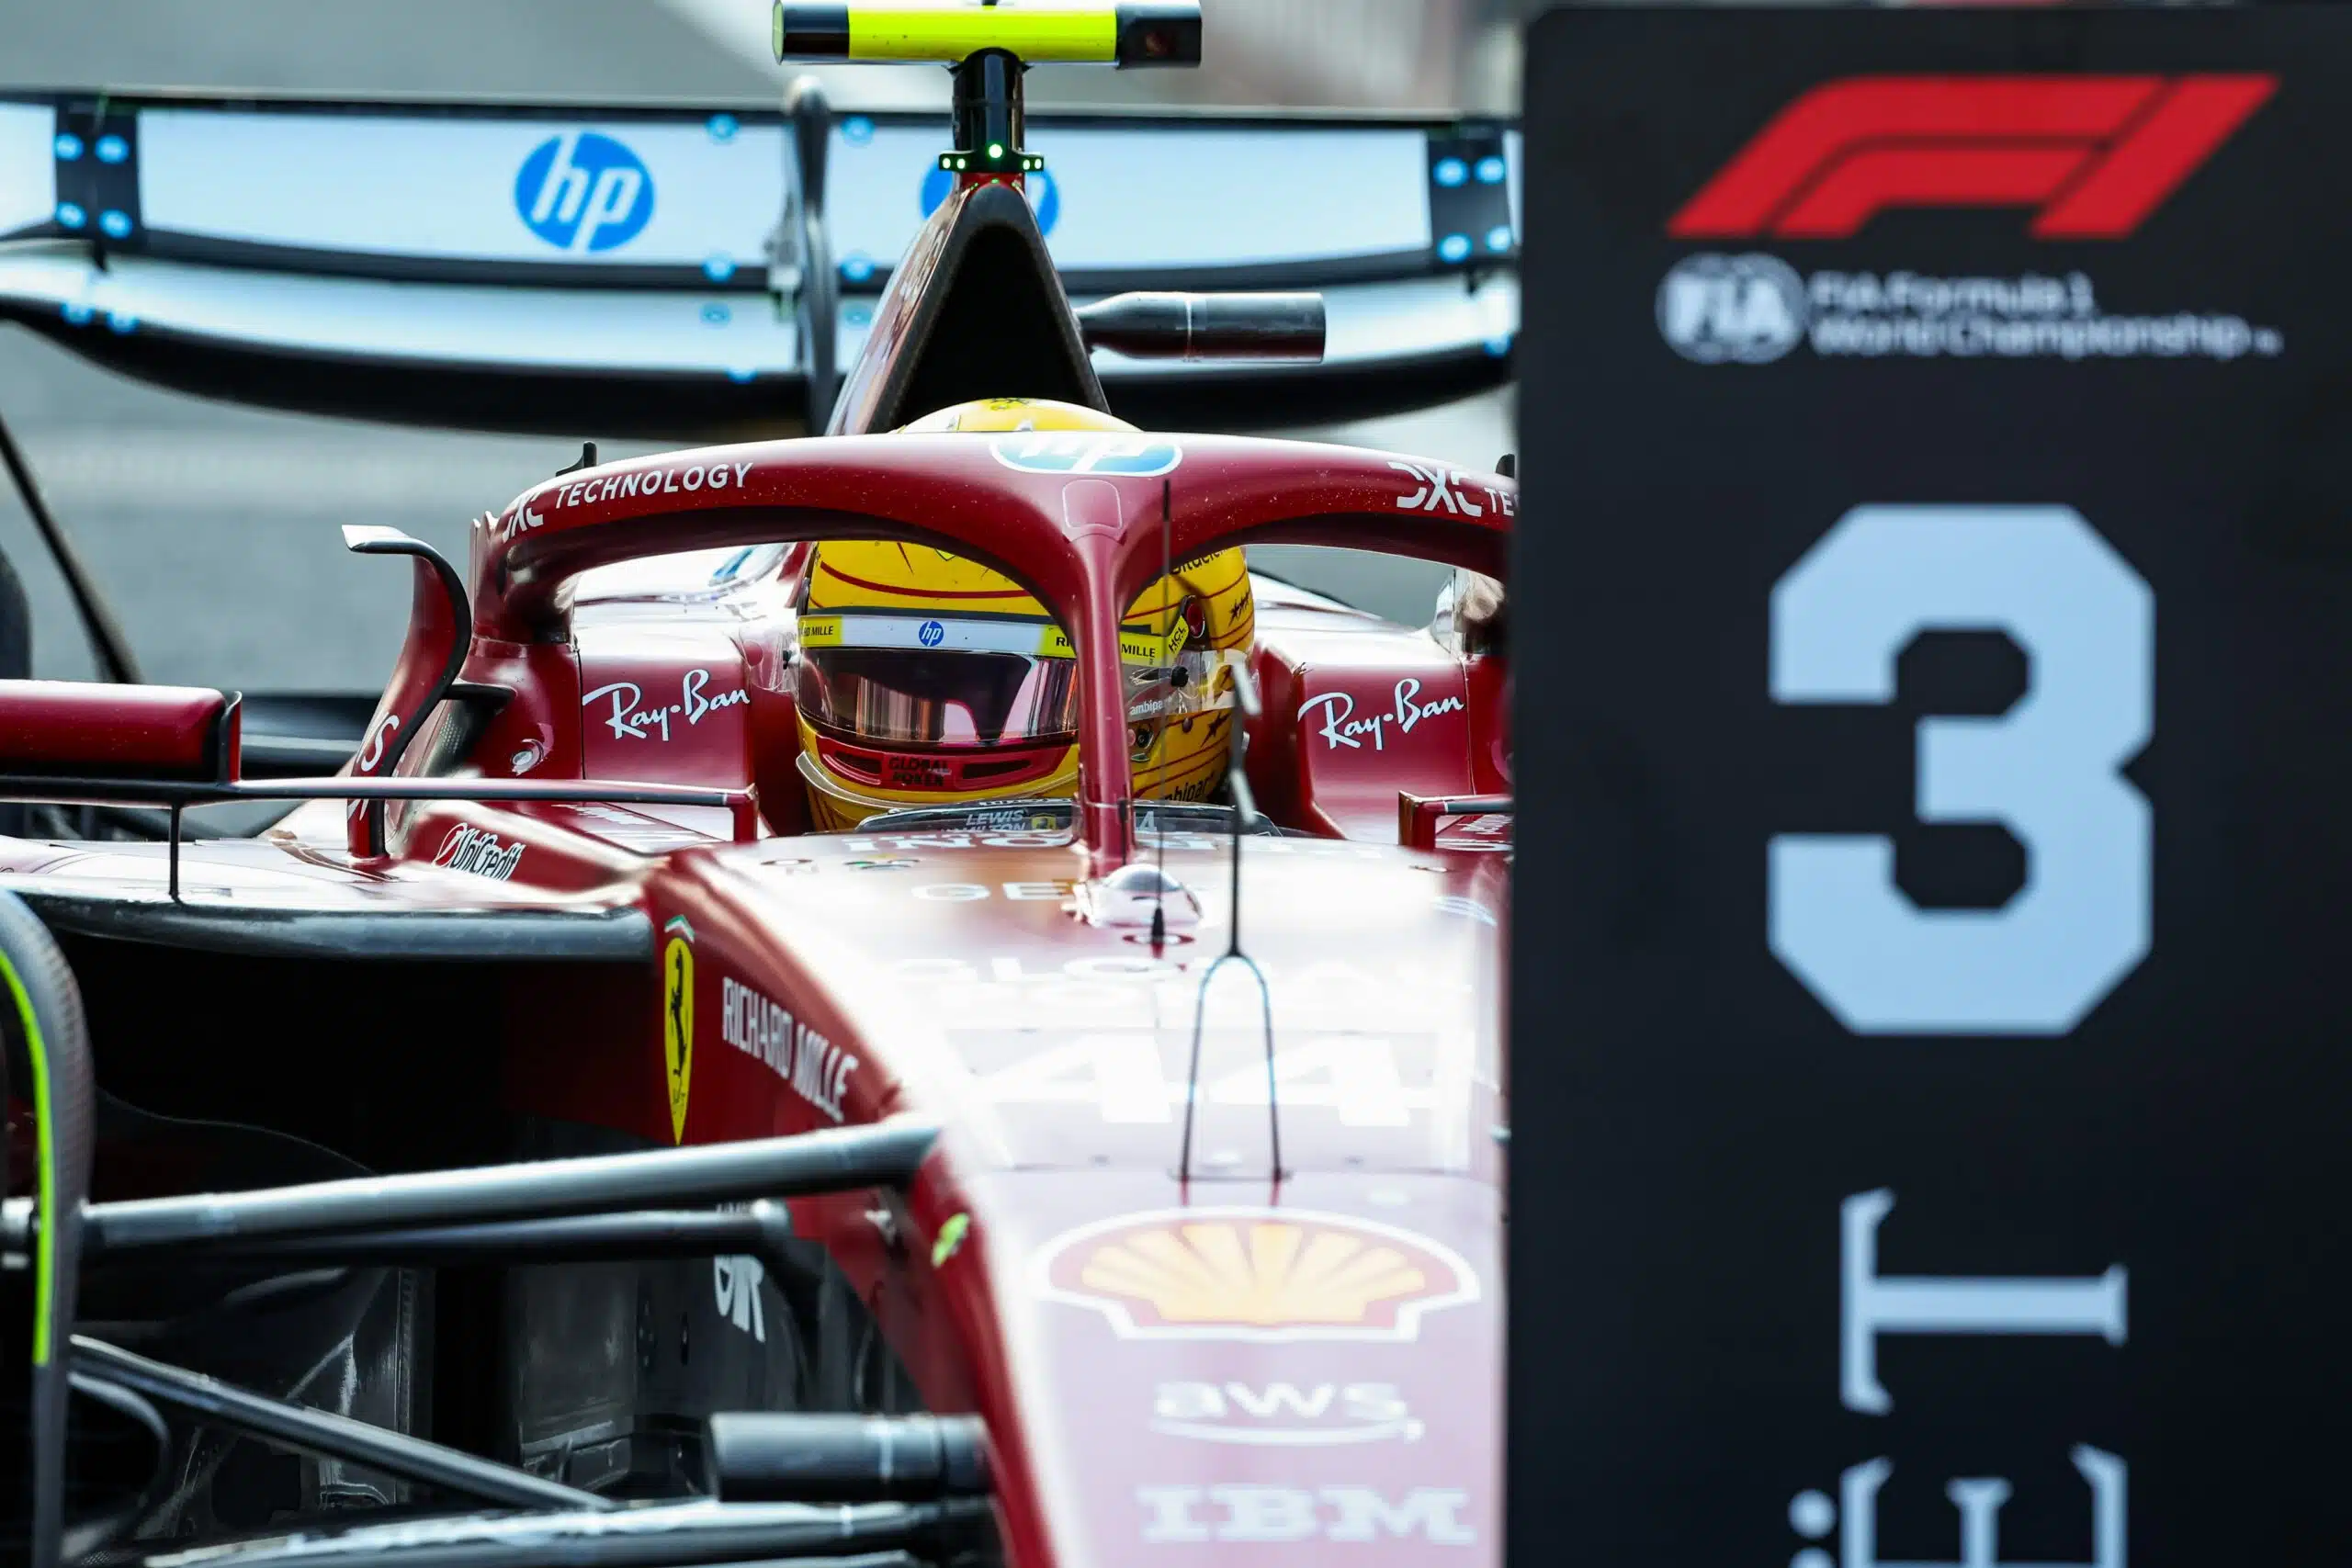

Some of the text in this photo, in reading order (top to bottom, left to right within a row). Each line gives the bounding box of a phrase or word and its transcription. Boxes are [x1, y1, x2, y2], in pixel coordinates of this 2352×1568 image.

[1666, 73, 2279, 238] F1
[529, 133, 643, 253] hp
[555, 462, 753, 509] TECHNOLOGY
[1386, 461, 1482, 517] DXC
[811, 626, 833, 636] MILLE
[921, 621, 943, 647] hp
[1121, 644, 1155, 658] MILLE
[582, 669, 750, 741] Ray-Ban
[1297, 678, 1465, 750] Ray-Ban
[1769, 503, 2155, 1035] 3
[966, 809, 1024, 826] LEWIS
[448, 828, 525, 880] UniCredit
[723, 976, 859, 1122] RICHARD MILLE
[1154, 1381, 1408, 1420] aws
[1136, 1483, 1477, 1545] IBM
